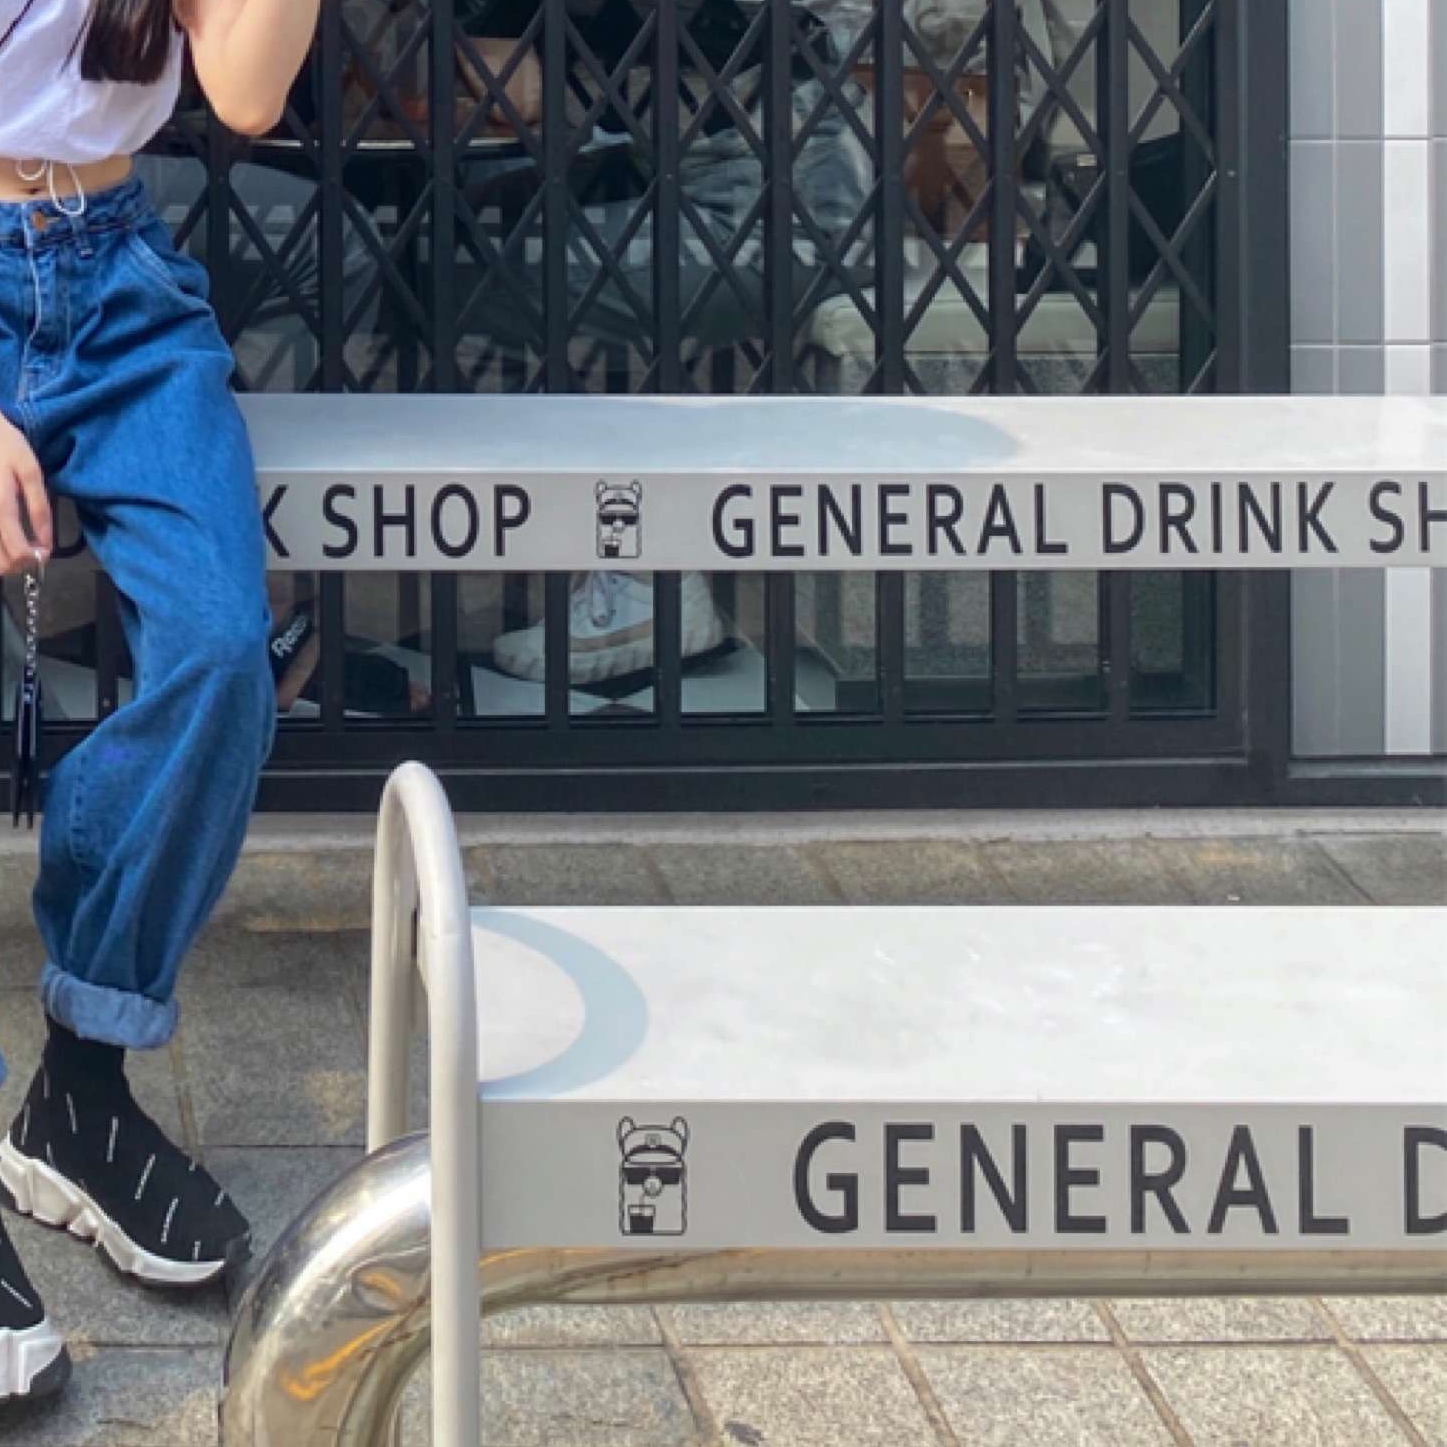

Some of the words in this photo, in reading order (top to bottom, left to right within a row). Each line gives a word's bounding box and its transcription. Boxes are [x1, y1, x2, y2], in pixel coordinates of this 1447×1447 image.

[321, 483, 533, 560] SHOP
[712, 483, 1069, 558] GENERAL
[1101, 481, 1339, 554] DRINK
[793, 1121, 1351, 1236] GENERAL
